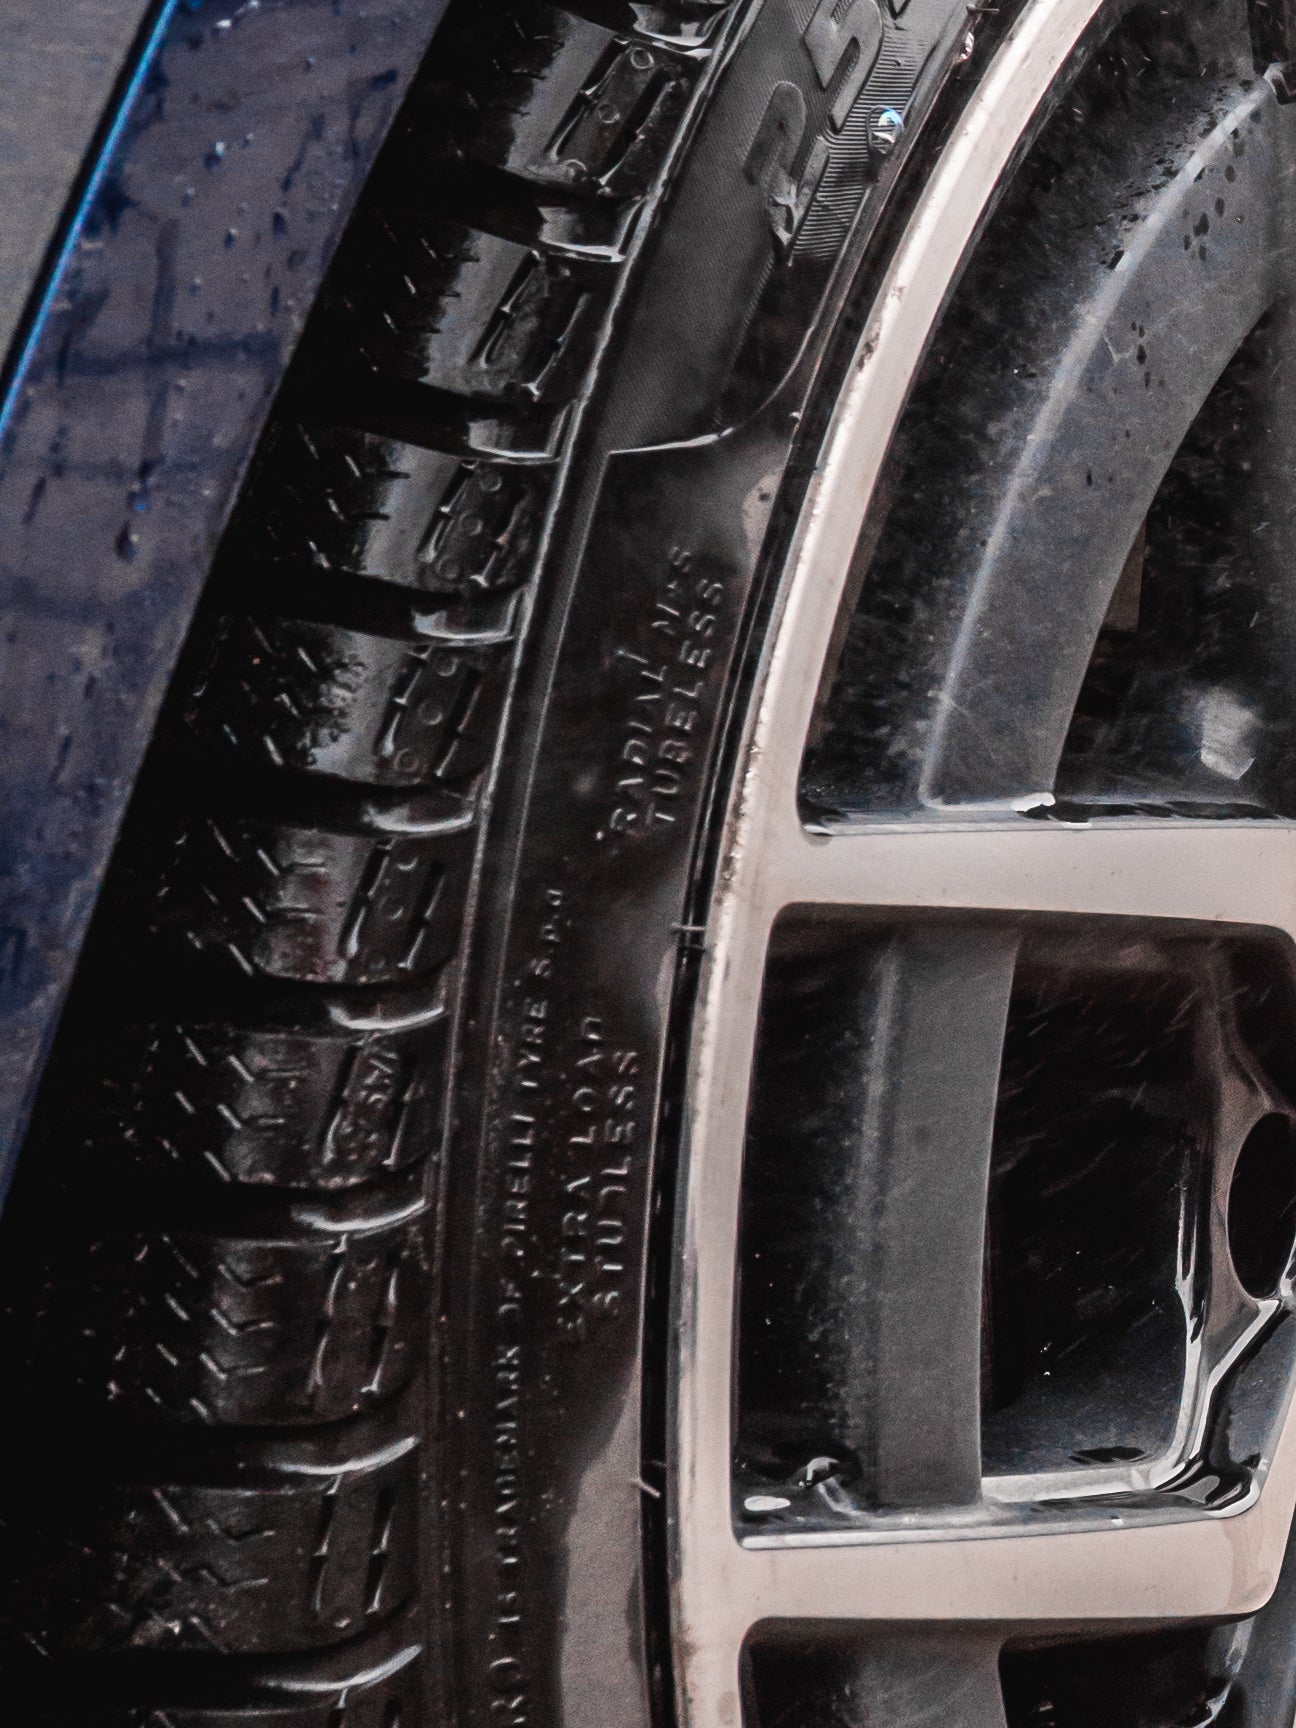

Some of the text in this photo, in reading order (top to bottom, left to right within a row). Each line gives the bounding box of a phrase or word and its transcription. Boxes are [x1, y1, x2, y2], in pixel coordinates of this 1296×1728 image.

[645, 578, 723, 826] TUBELESS
[500, 1111, 536, 1260] PIRELLI
[557, 1015, 604, 1334] EXTRA LOAD
